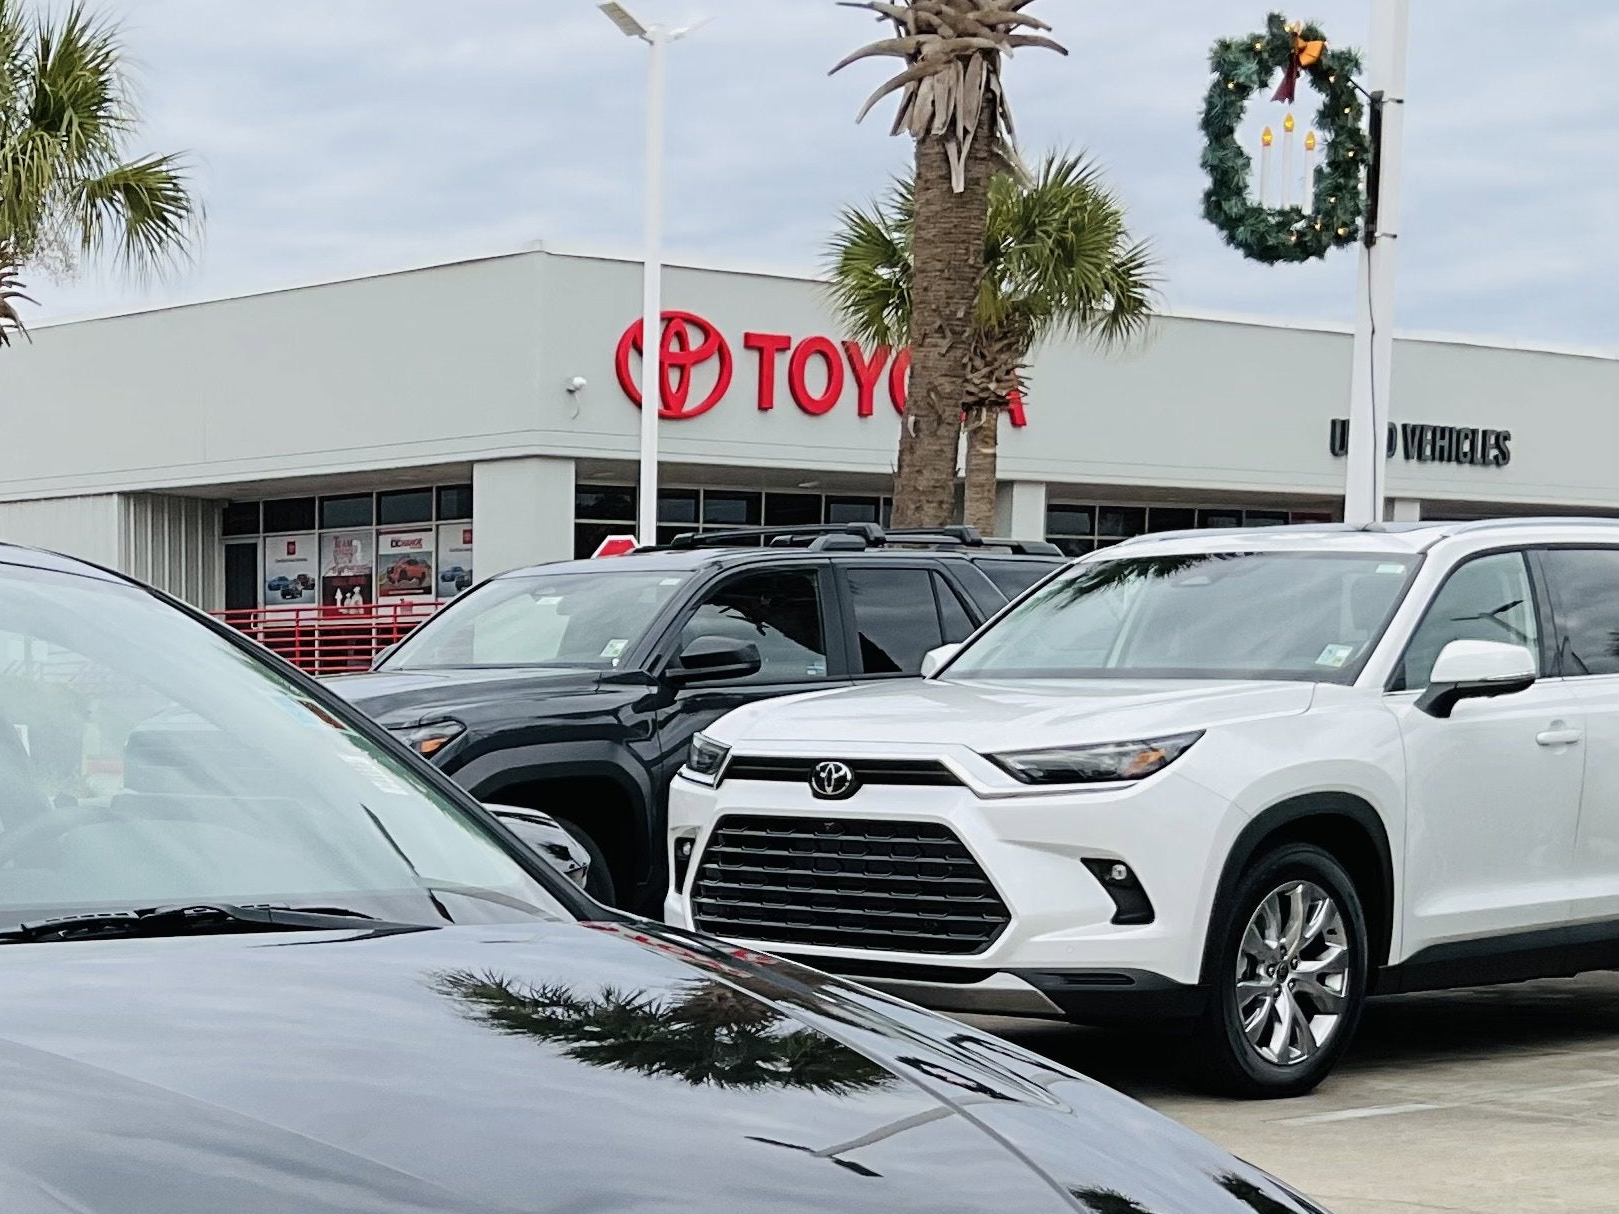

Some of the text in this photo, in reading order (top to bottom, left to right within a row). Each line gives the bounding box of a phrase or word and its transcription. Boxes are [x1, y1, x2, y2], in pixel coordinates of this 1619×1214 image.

[744, 332, 1027, 427] TOY
[1330, 418, 1511, 466] UD VEHICLES
